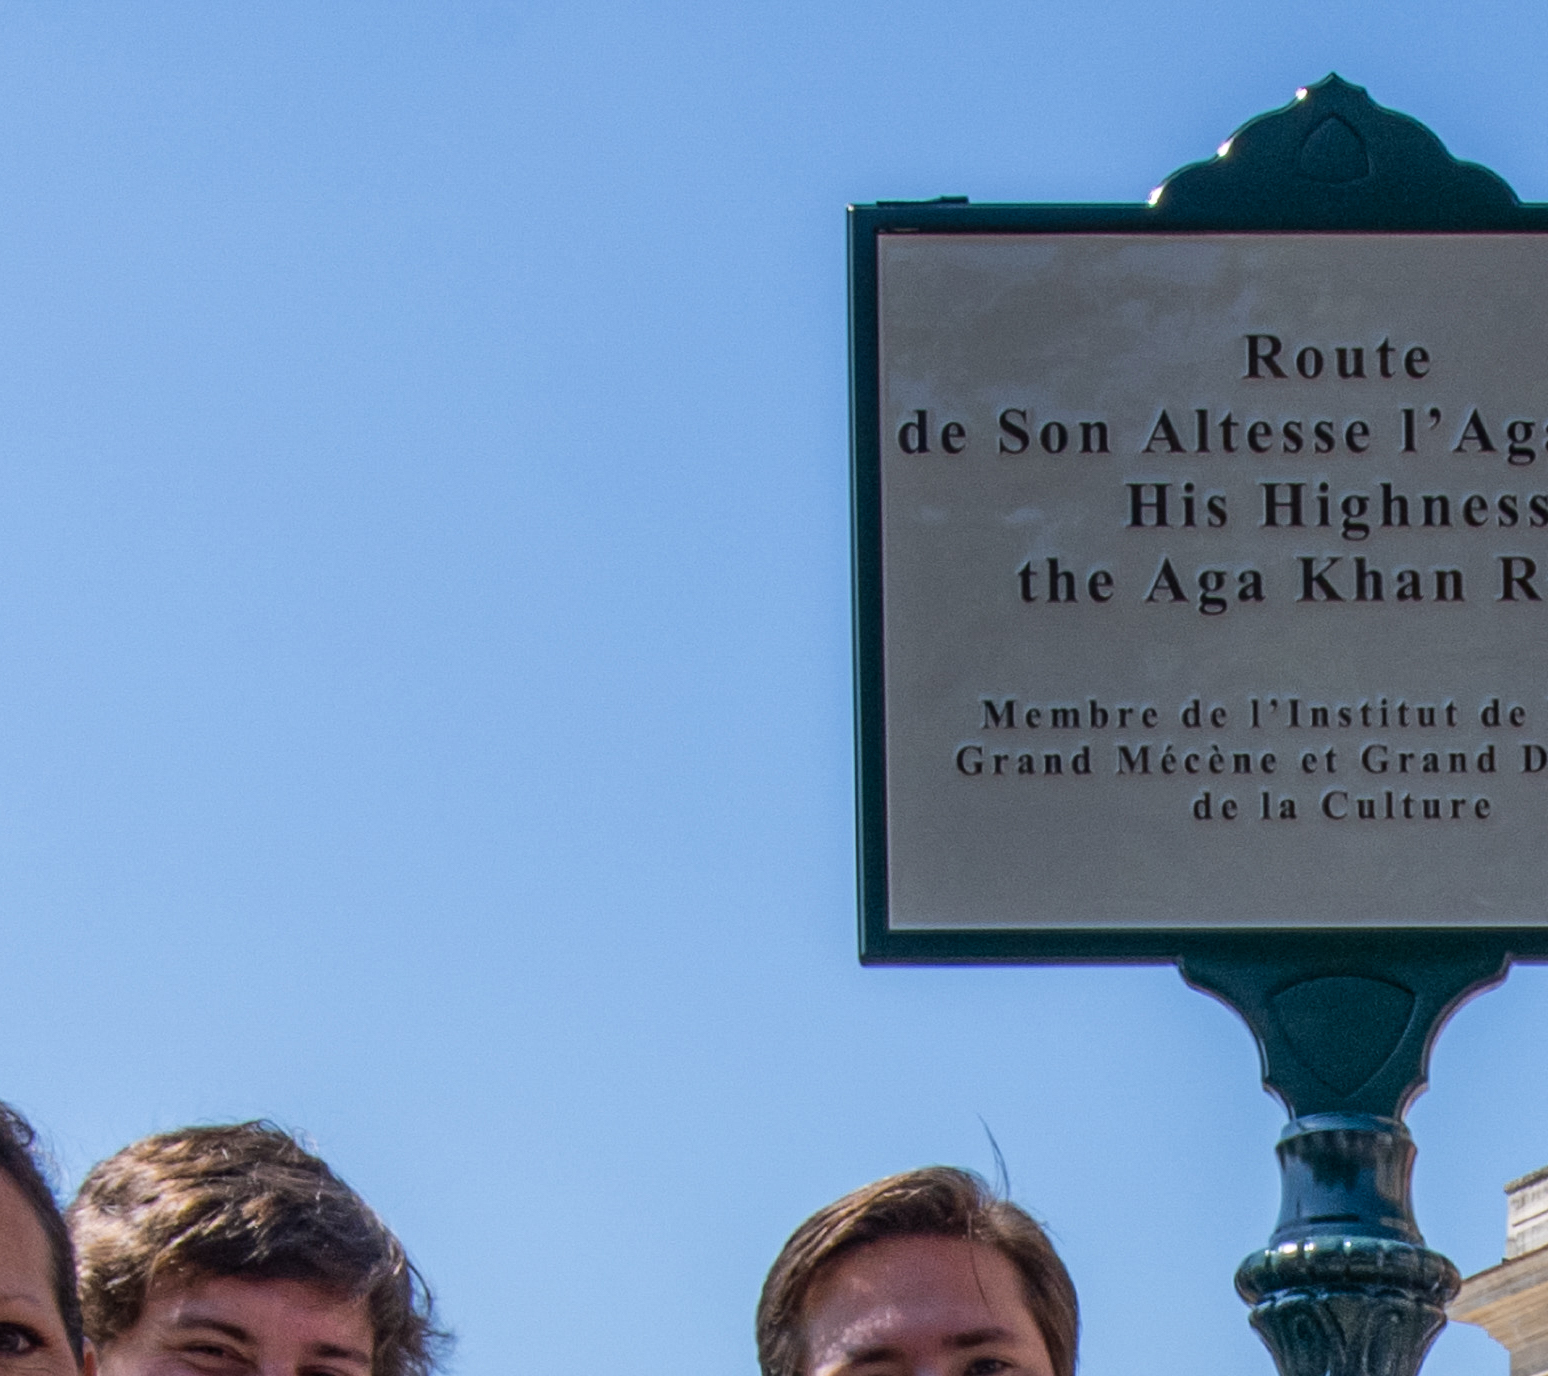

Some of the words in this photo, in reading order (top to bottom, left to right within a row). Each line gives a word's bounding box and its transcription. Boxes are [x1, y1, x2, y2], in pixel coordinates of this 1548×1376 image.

[1242, 333, 1431, 381] Route
[897, 408, 967, 456] de
[998, 407, 1111, 456] Son
[1141, 407, 1371, 455] Altesse
[1125, 481, 1229, 530] His
[1017, 556, 1115, 605] the
[1145, 557, 1266, 614] Aga
[1296, 555, 1466, 603] Khan
[982, 698, 1159, 731] Membre
[1180, 698, 1228, 730] de
[1479, 697, 1527, 729] de
[955, 744, 1093, 778] Grand
[1117, 743, 1278, 776] Mécène
[1300, 748, 1337, 775] et
[1360, 743, 1497, 776] Grand
[1192, 790, 1239, 822] de
[1261, 790, 1298, 821] la
[1320, 790, 1491, 822] Culture
